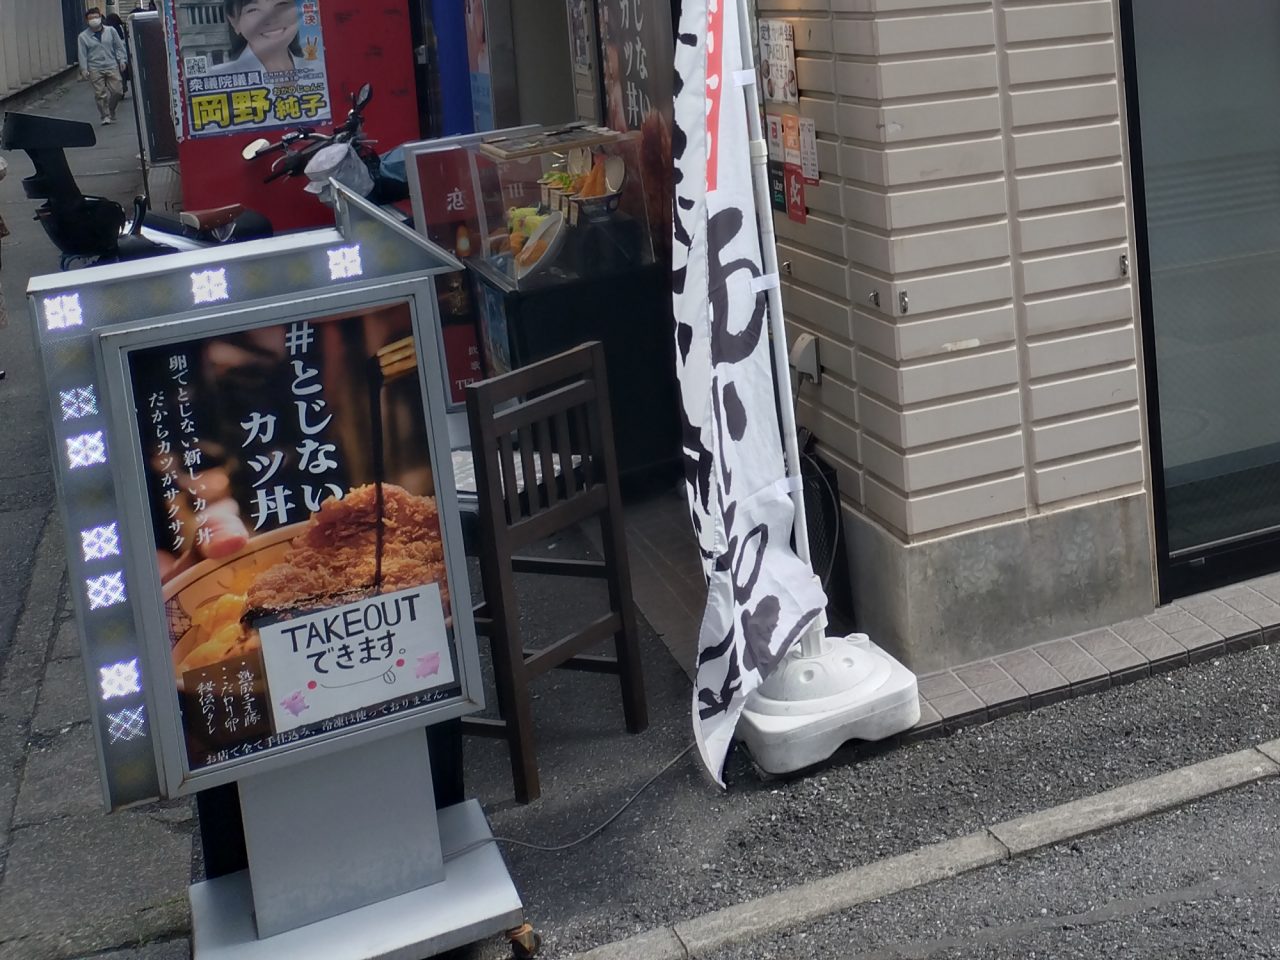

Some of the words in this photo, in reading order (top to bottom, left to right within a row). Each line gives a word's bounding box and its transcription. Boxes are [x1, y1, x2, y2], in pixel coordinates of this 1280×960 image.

[189, 72, 261, 92] 衆議院議員
[190, 88, 328, 132] 岡野純子
[148, 390, 185, 551] だからカツがサクサク
[168, 354, 213, 546] 卵でとじない新しいカツ丼
[240, 411, 296, 531] カツ丼
[285, 320, 344, 513] #とじない
[281, 593, 421, 655] TAKEOUT
